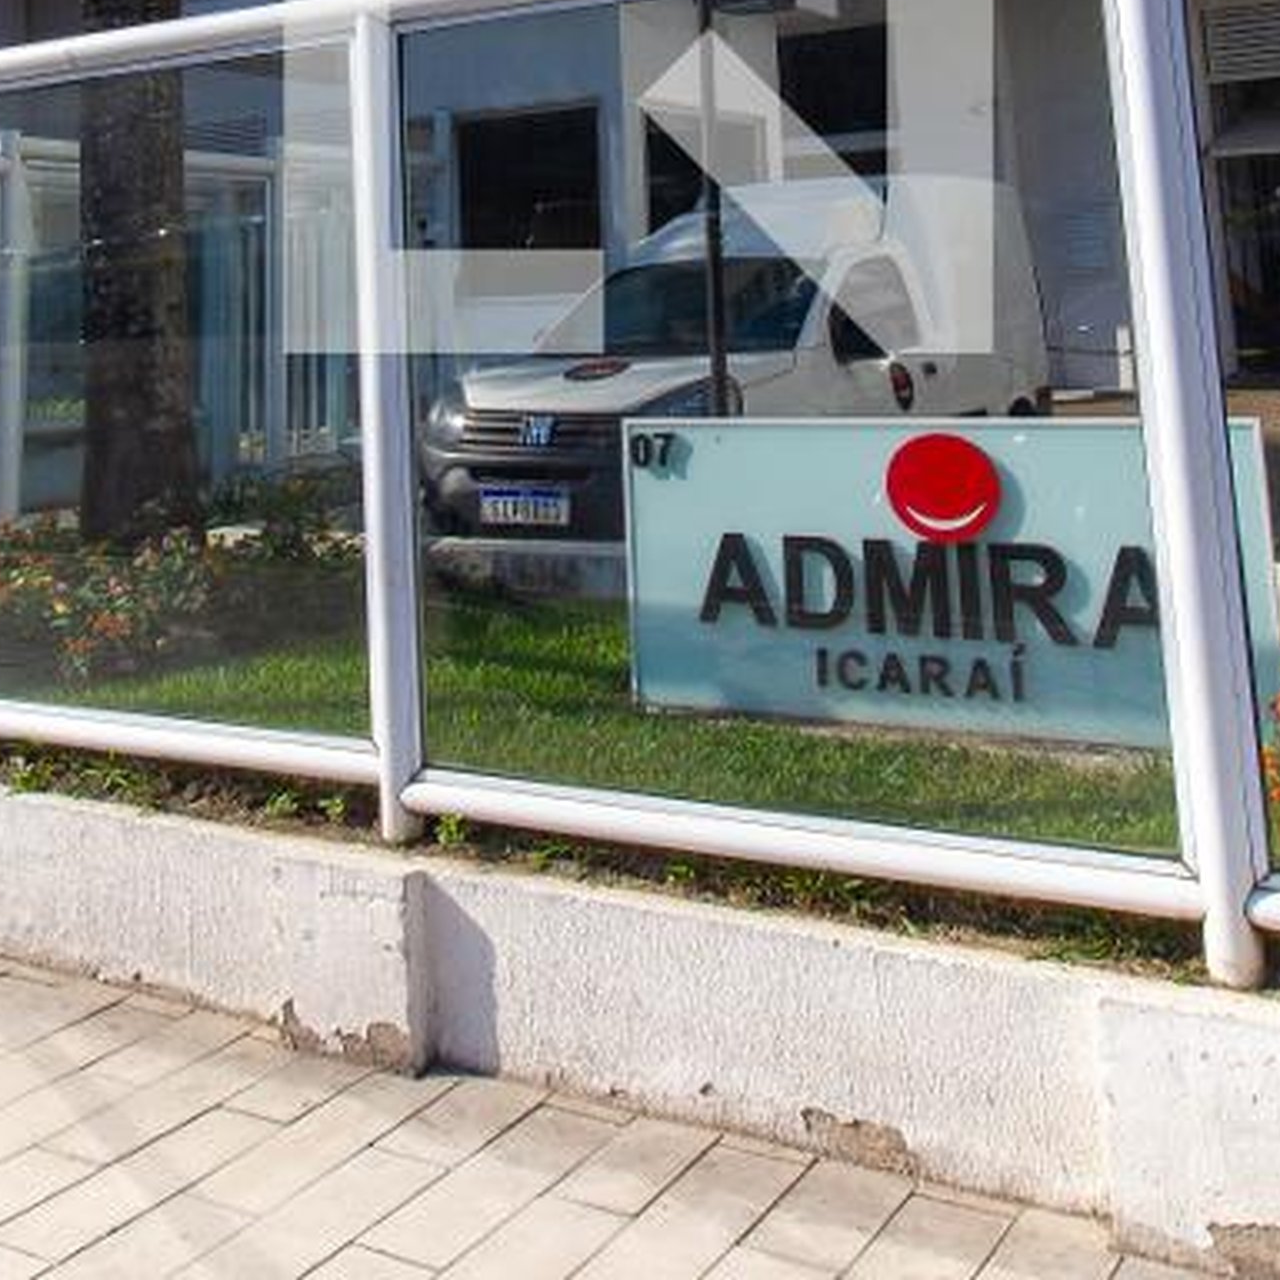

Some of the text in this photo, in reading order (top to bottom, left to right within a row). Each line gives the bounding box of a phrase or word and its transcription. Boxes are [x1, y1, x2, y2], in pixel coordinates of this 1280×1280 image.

[631, 432, 676, 468] 07
[699, 532, 1160, 648] ADMIRA
[816, 643, 1026, 702] ICARAÍ
